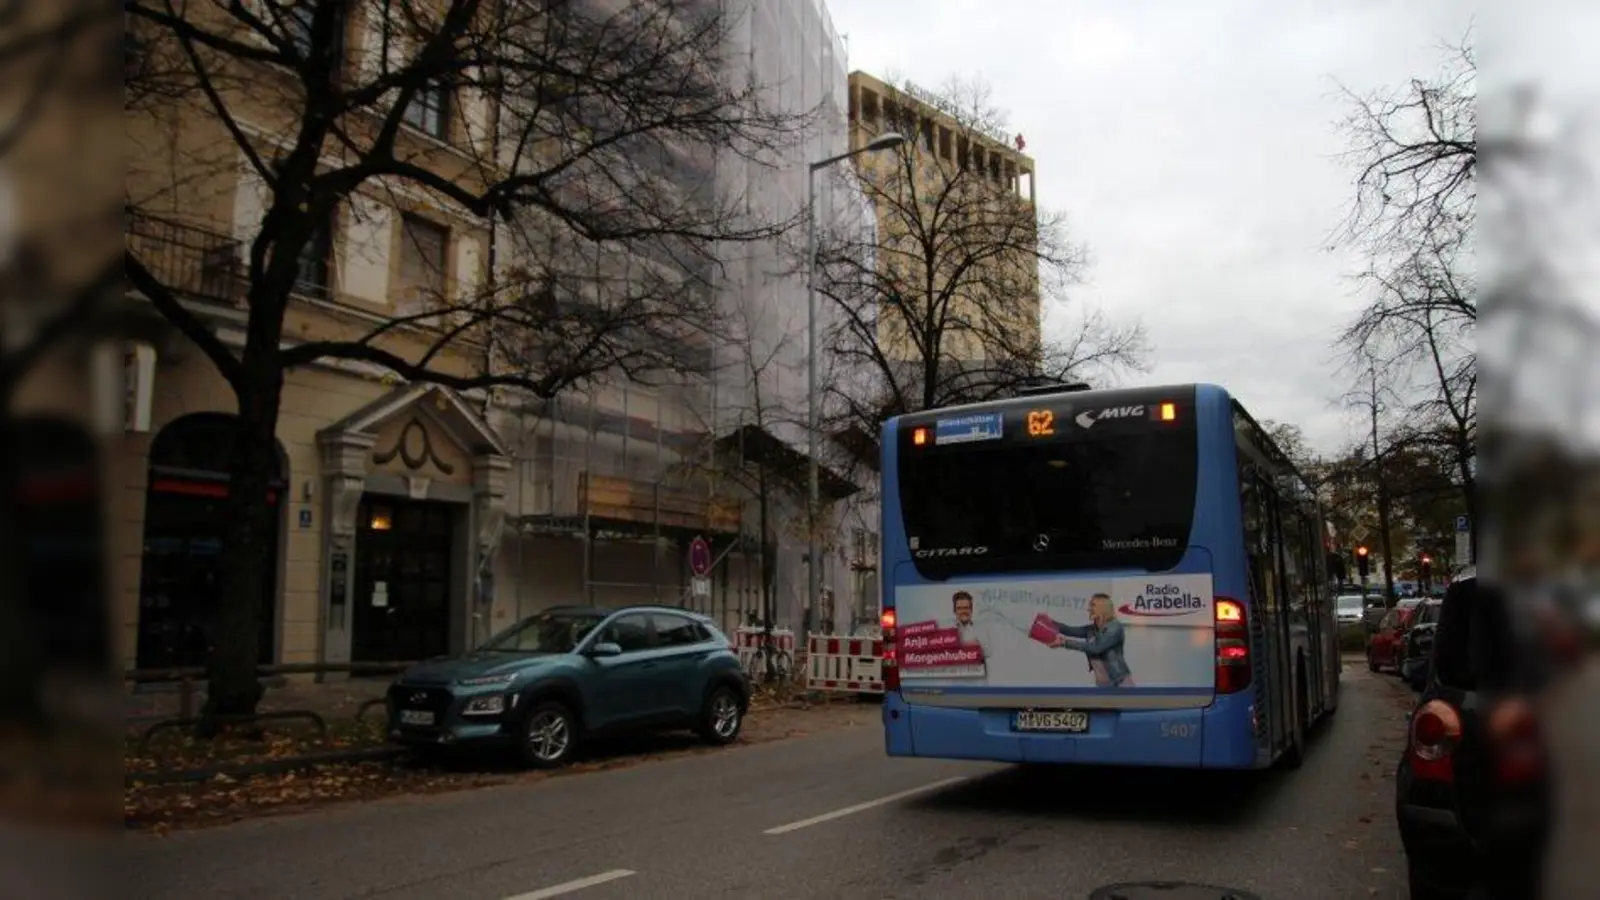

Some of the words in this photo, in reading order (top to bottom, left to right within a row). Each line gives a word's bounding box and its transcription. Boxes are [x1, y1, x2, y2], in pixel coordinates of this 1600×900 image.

[1097, 404, 1145, 420] MVG
[1028, 409, 1054, 434] 62
[1456, 516, 1467, 529] P
[1102, 536, 1179, 550] Mercedes-Benz
[915, 545, 988, 559] CITARO
[1145, 583, 1180, 596] Radio
[903, 636, 928, 649] Anja
[904, 648, 978, 665] Morgenhuber
[1160, 722, 1198, 738] 5407
